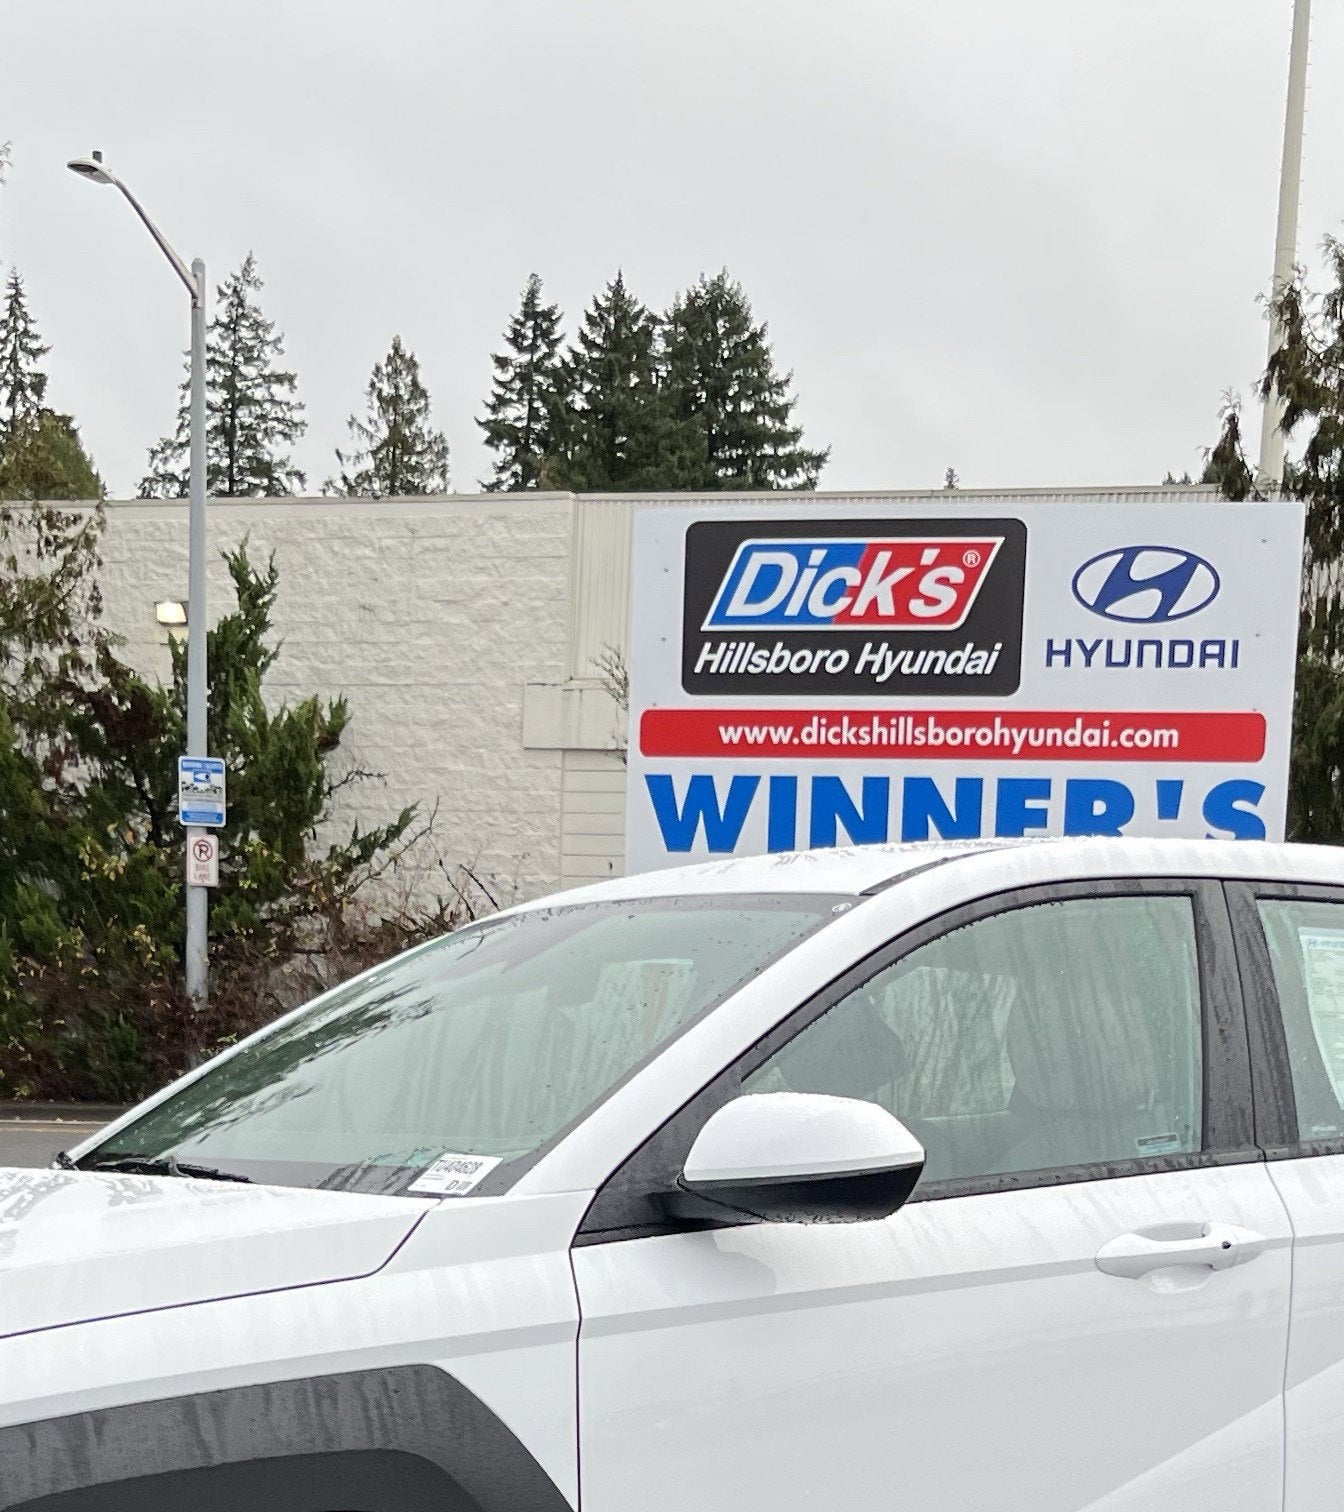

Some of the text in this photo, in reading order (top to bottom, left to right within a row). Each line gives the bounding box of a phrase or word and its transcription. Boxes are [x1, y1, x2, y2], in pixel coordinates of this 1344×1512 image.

[694, 642, 1002, 683] Hillsboro Hyundai
[1046, 639, 1238, 669] HYUNDAI
[718, 717, 1180, 755] www.dickshillsborohyundai.com
